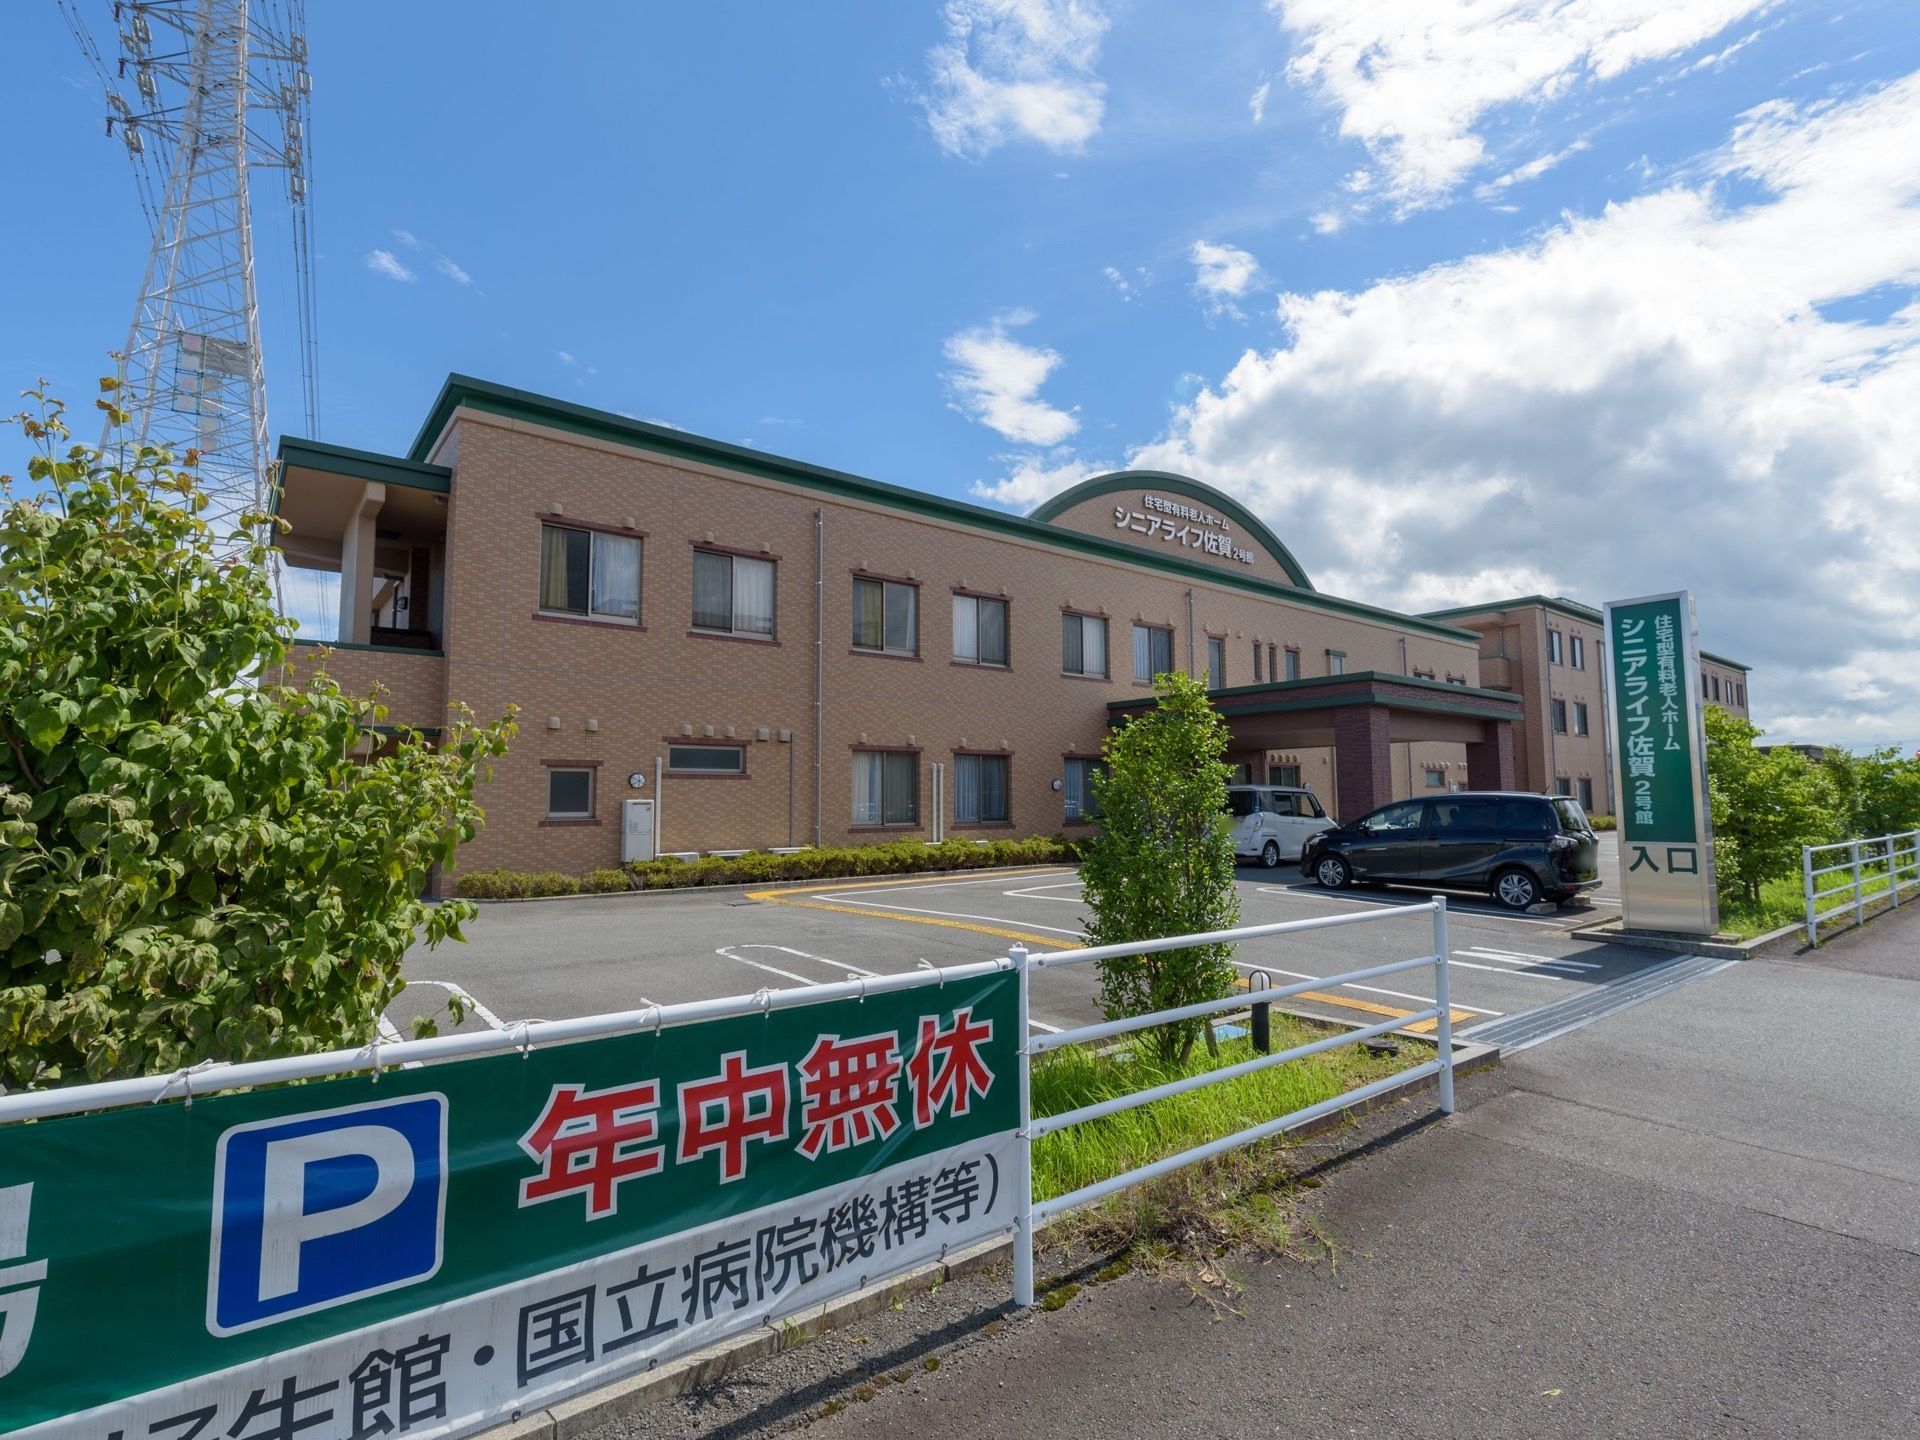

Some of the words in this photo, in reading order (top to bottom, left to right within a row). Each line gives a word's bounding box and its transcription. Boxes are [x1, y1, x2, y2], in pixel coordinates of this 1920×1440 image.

[1144, 494, 1230, 531] 住宅型有料老人ホーム
[1654, 614, 1681, 751] 住宅型有料老人ホーム
[1628, 845, 1698, 875] 入口
[517, 1006, 997, 1223] 年中無休
[258, 1124, 416, 1302] P
